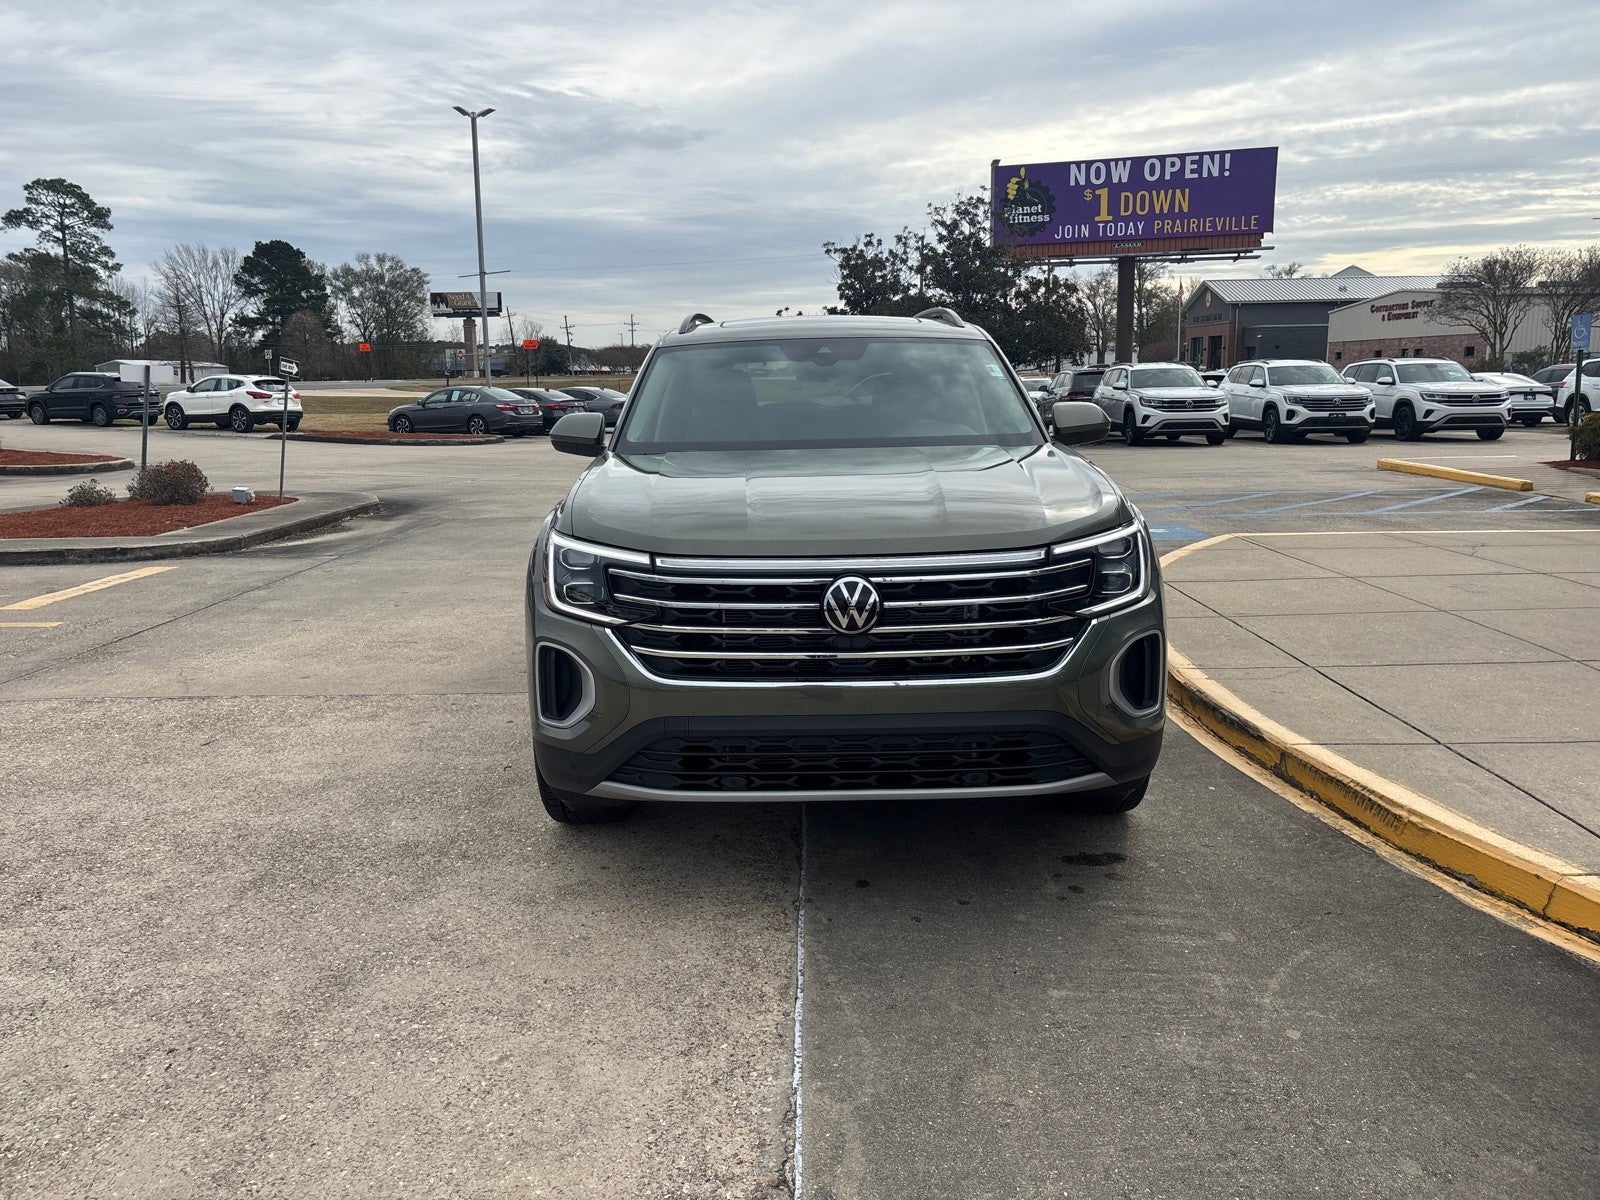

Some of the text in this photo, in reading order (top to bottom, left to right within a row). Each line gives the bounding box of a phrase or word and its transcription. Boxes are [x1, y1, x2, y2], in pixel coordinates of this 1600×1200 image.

[1069, 152, 1232, 187] NOW OPEN!
[1008, 213, 1050, 224] fitness
[1083, 187, 1190, 222] $1 DOWN
[1054, 215, 1259, 240] JOIN TODAY PRAIRIEVILLE
